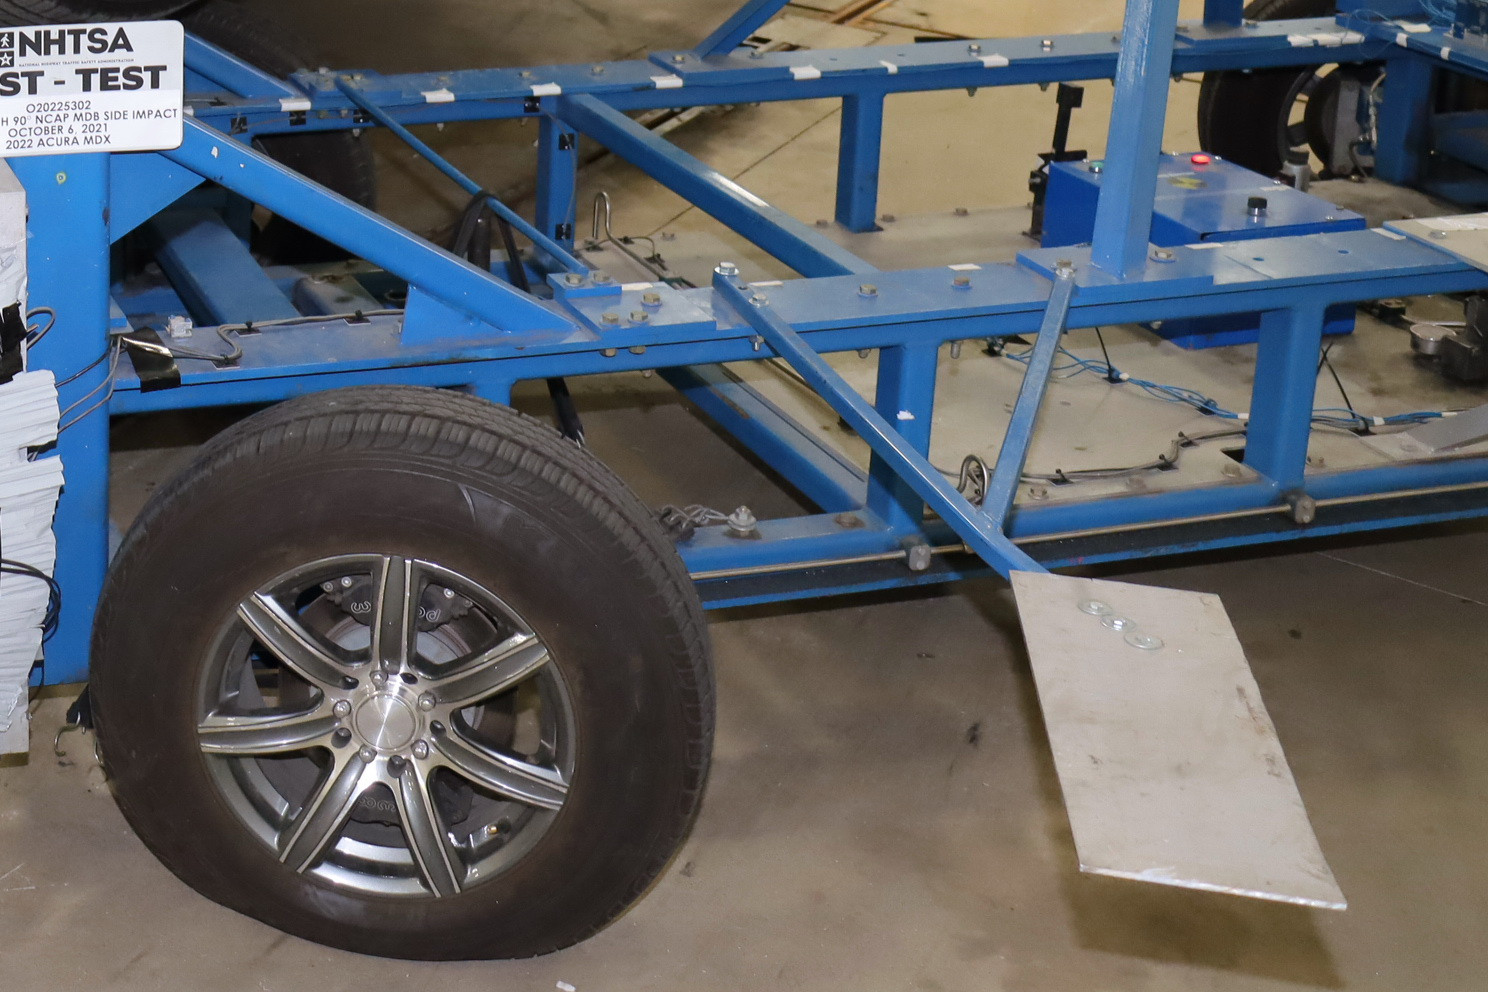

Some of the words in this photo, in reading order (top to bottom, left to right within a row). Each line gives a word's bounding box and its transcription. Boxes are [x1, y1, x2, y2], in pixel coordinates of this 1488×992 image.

[18, 26, 134, 57] NHTSA
[75, 65, 168, 93] TEST
[13, 114, 32, 126] 90°
[35, 113, 70, 124] NCAP
[73, 111, 100, 122] MDB
[103, 110, 130, 121] SIDE
[132, 108, 178, 120] IMPACT
[8, 125, 64, 139] OCTOBER
[68, 124, 78, 136] 6,
[81, 123, 108, 134] 2021
[5, 138, 34, 150] 2022
[37, 136, 80, 148] ACURA
[83, 134, 112, 146] MDX
